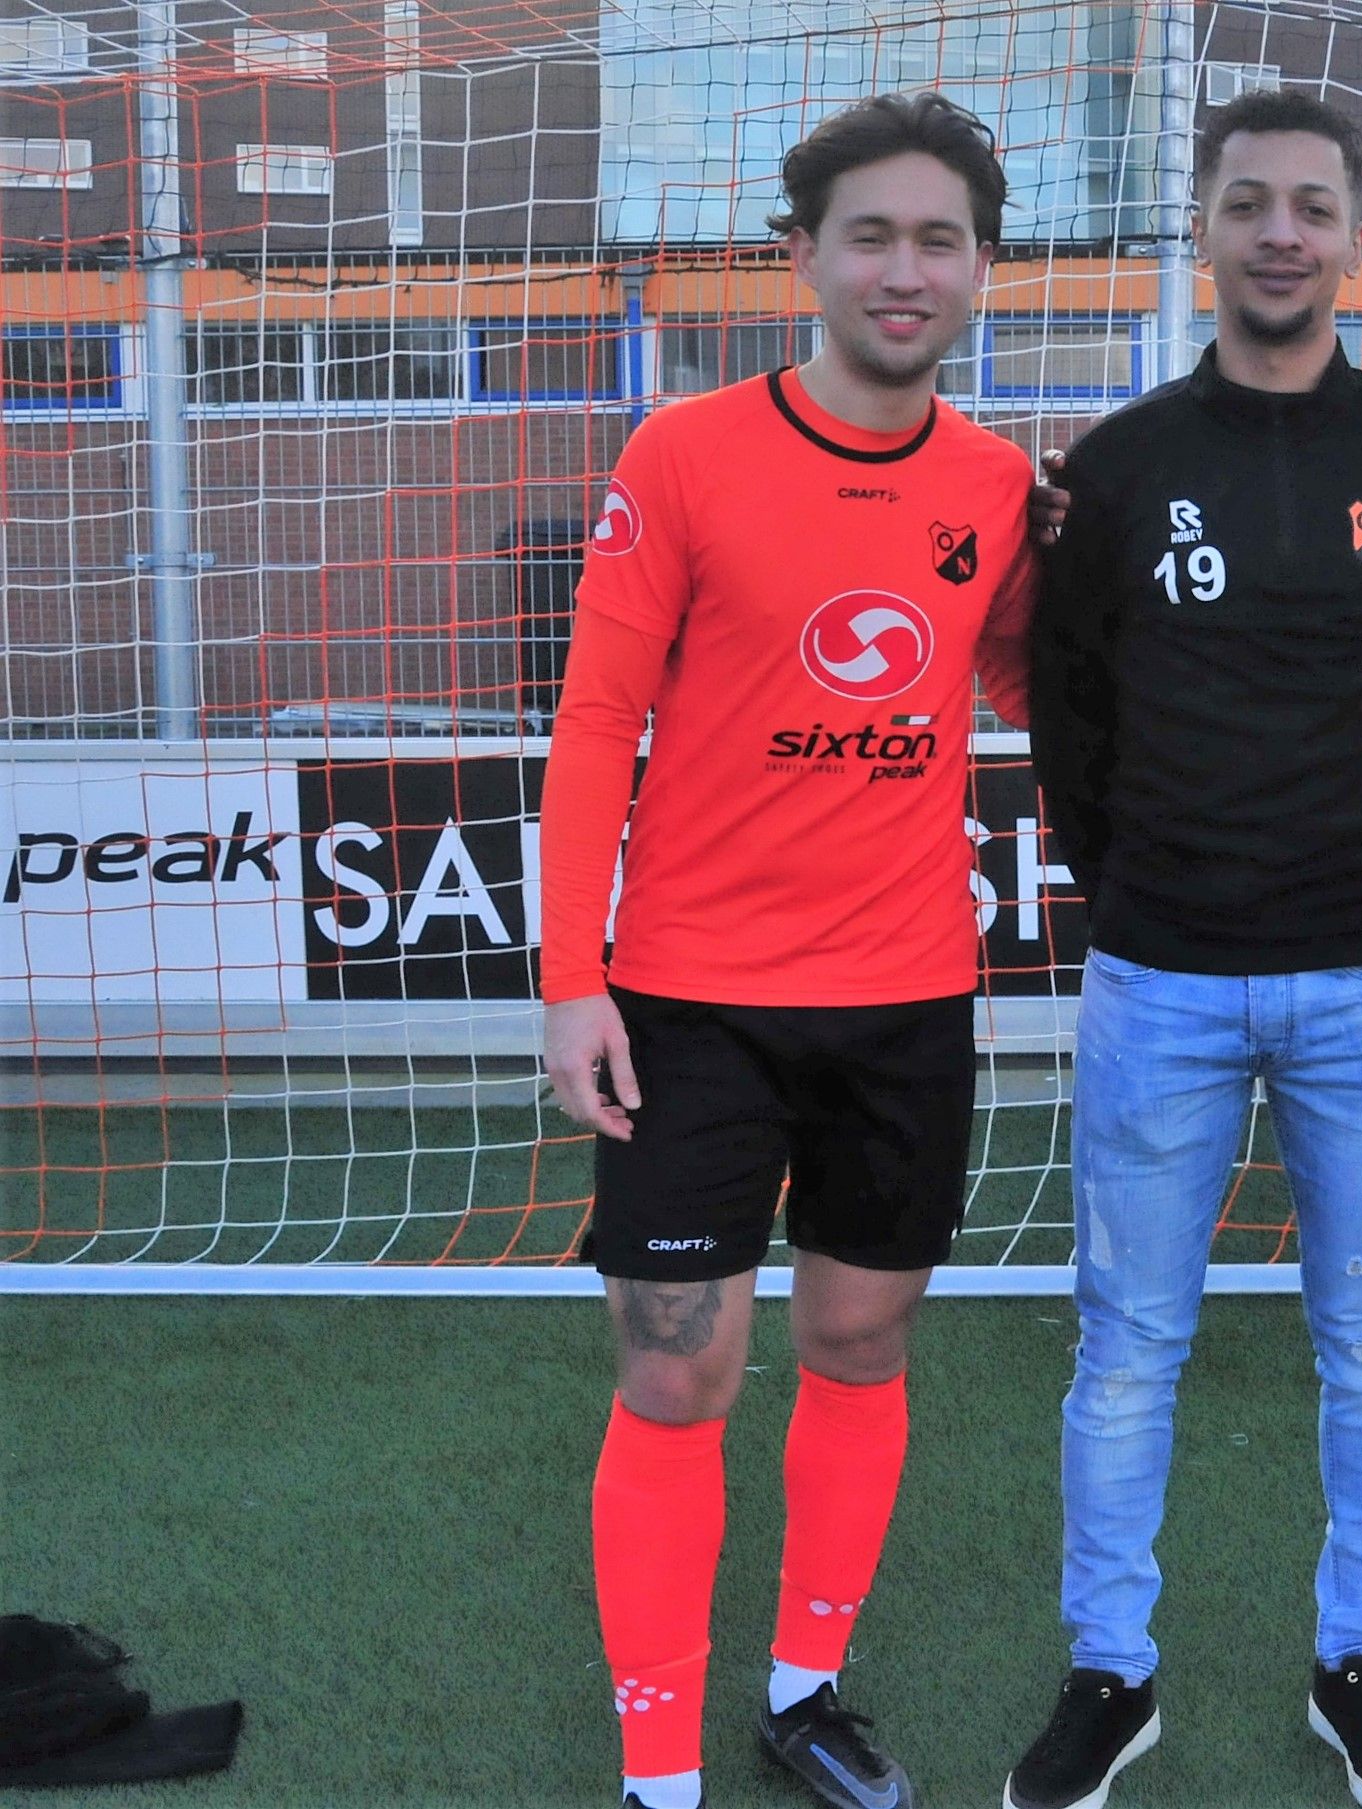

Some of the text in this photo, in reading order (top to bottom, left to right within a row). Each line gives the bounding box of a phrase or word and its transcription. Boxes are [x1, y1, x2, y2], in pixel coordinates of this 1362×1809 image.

[837, 487, 887, 500] CRAFT
[1170, 528, 1204, 545] ROBEY
[1153, 545, 1227, 605] 19
[767, 723, 937, 760] sixton
[868, 761, 928, 784] peak
[2, 810, 291, 903] peak
[647, 1239, 704, 1252] CRAFT
